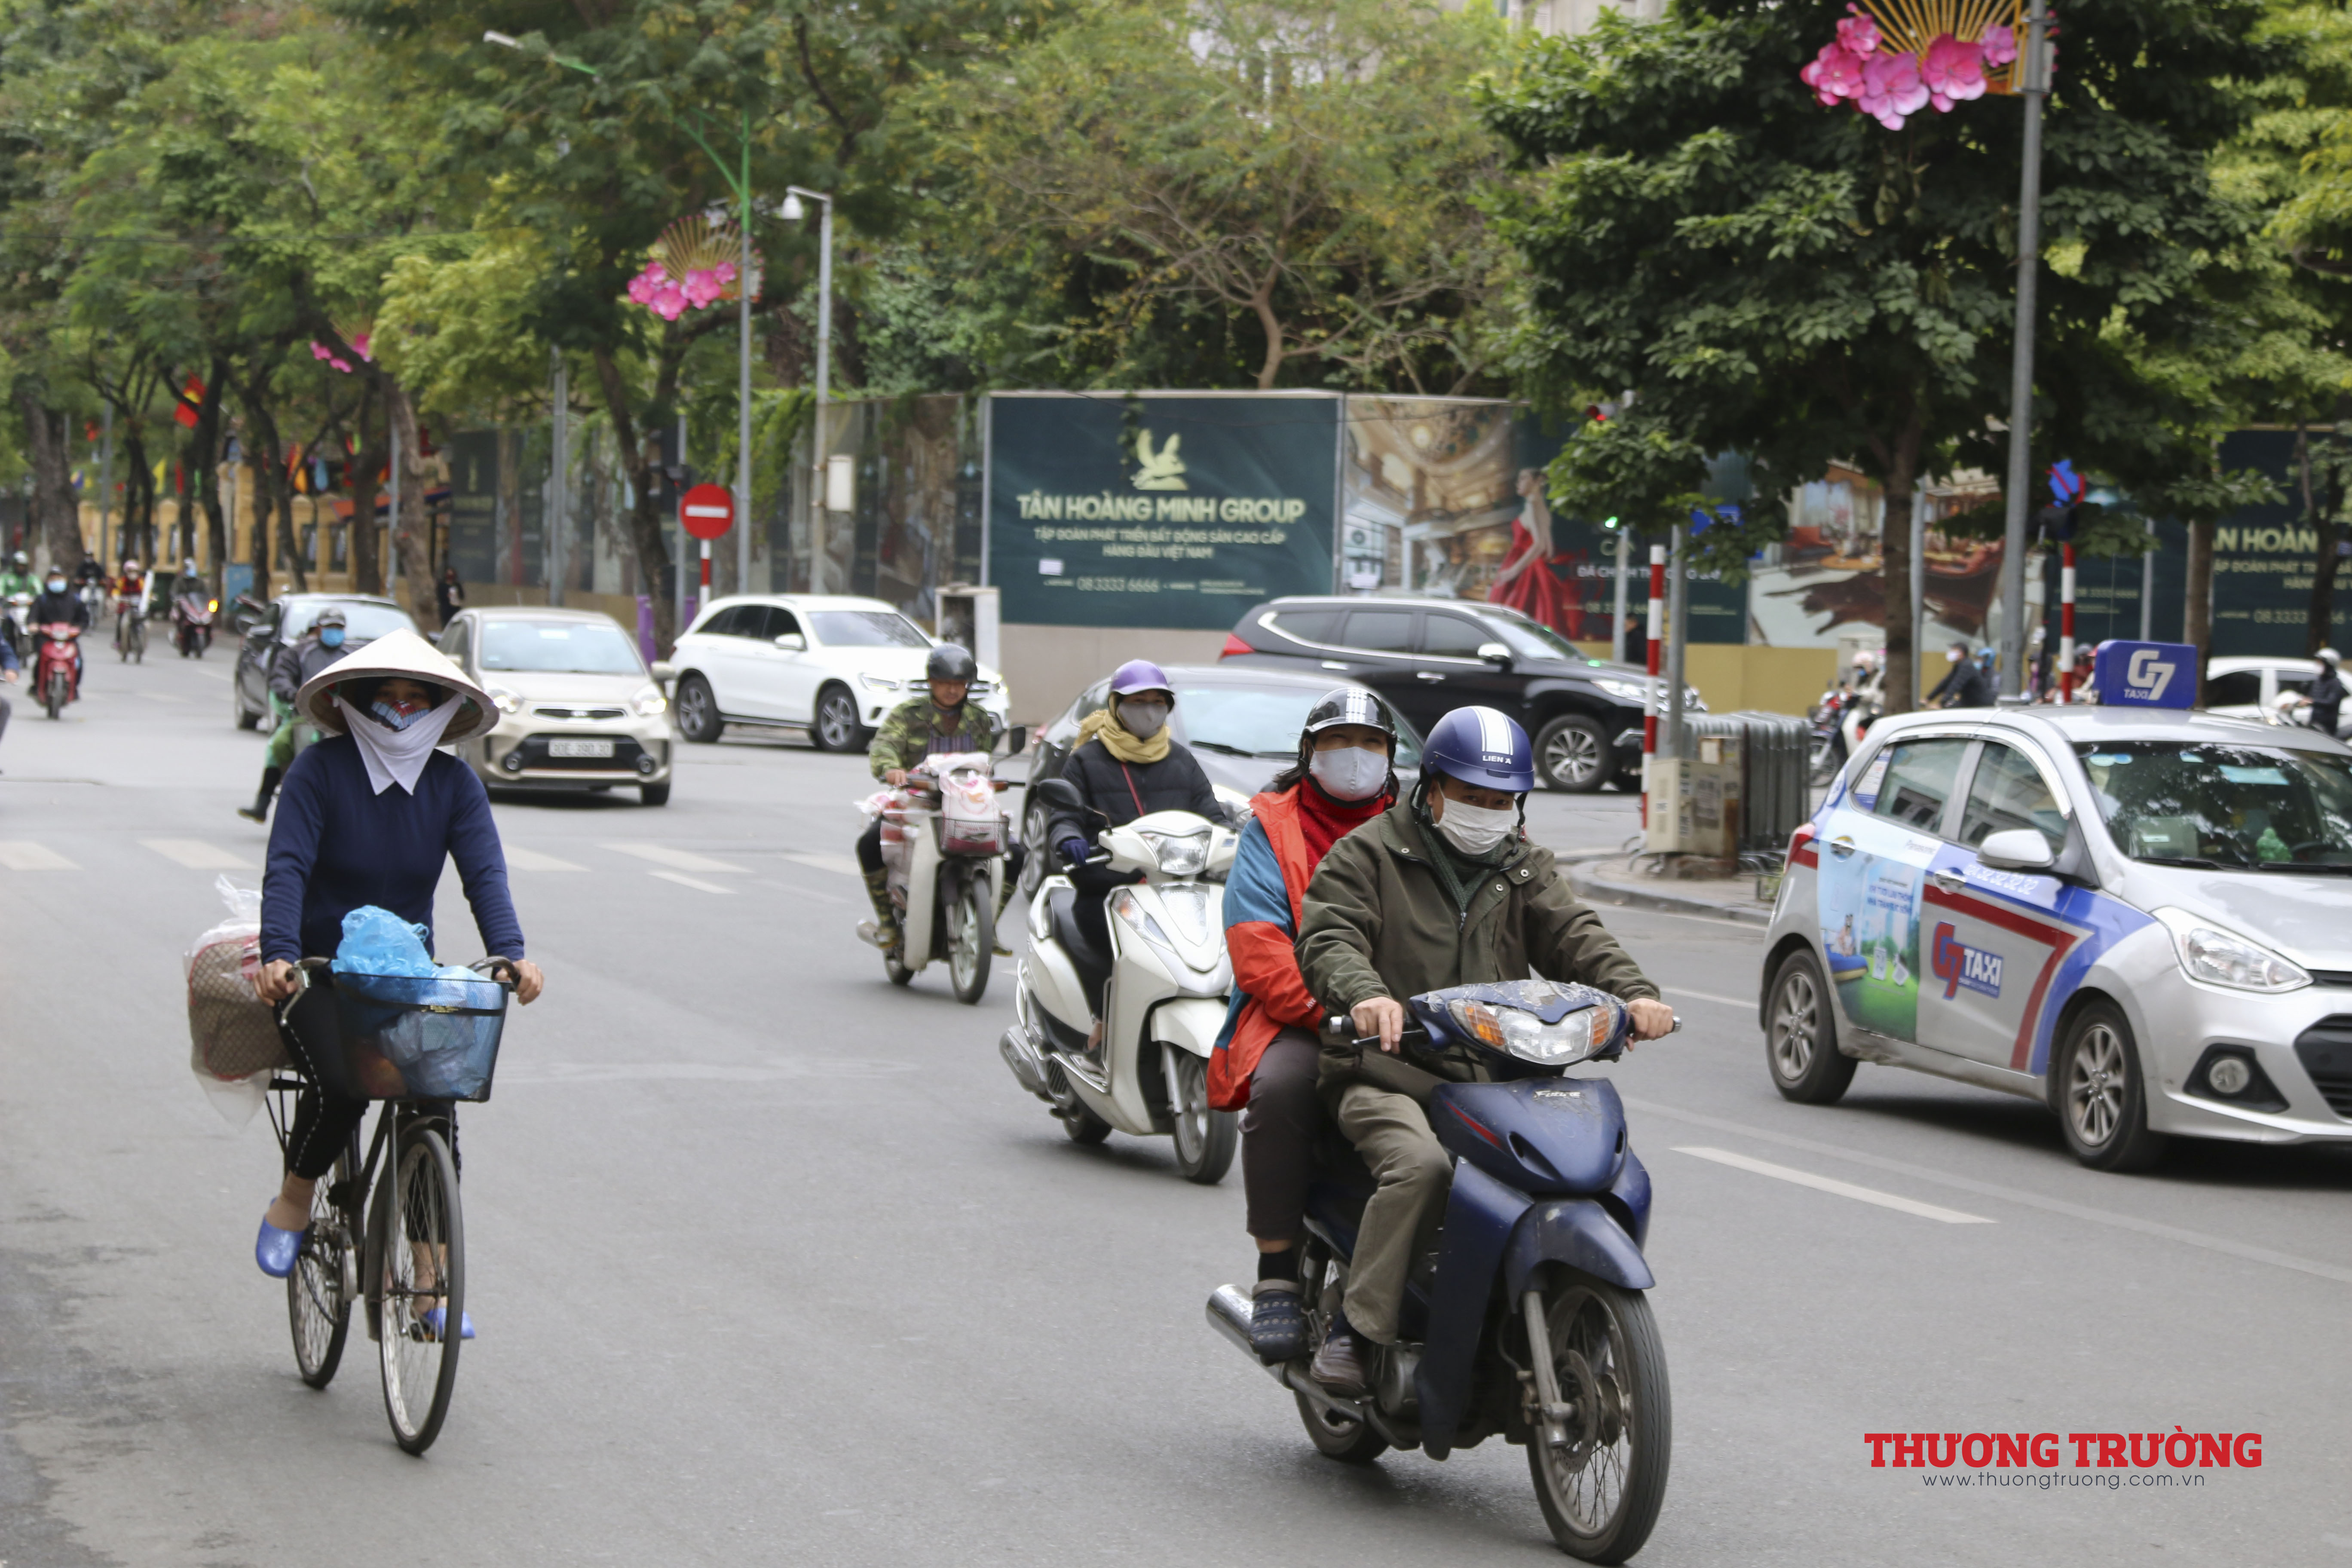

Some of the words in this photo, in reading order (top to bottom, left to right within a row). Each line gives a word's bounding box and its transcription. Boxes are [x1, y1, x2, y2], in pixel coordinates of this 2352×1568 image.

[1016, 489, 1062, 520] TÂN
[1065, 489, 1153, 521] HOÀNG
[1156, 496, 1218, 522] MINH
[1219, 497, 1306, 524] GROUP
[2128, 649, 2176, 701] G7
[2123, 689, 2150, 700] TAXI
[1964, 948, 2002, 986] TAXI
